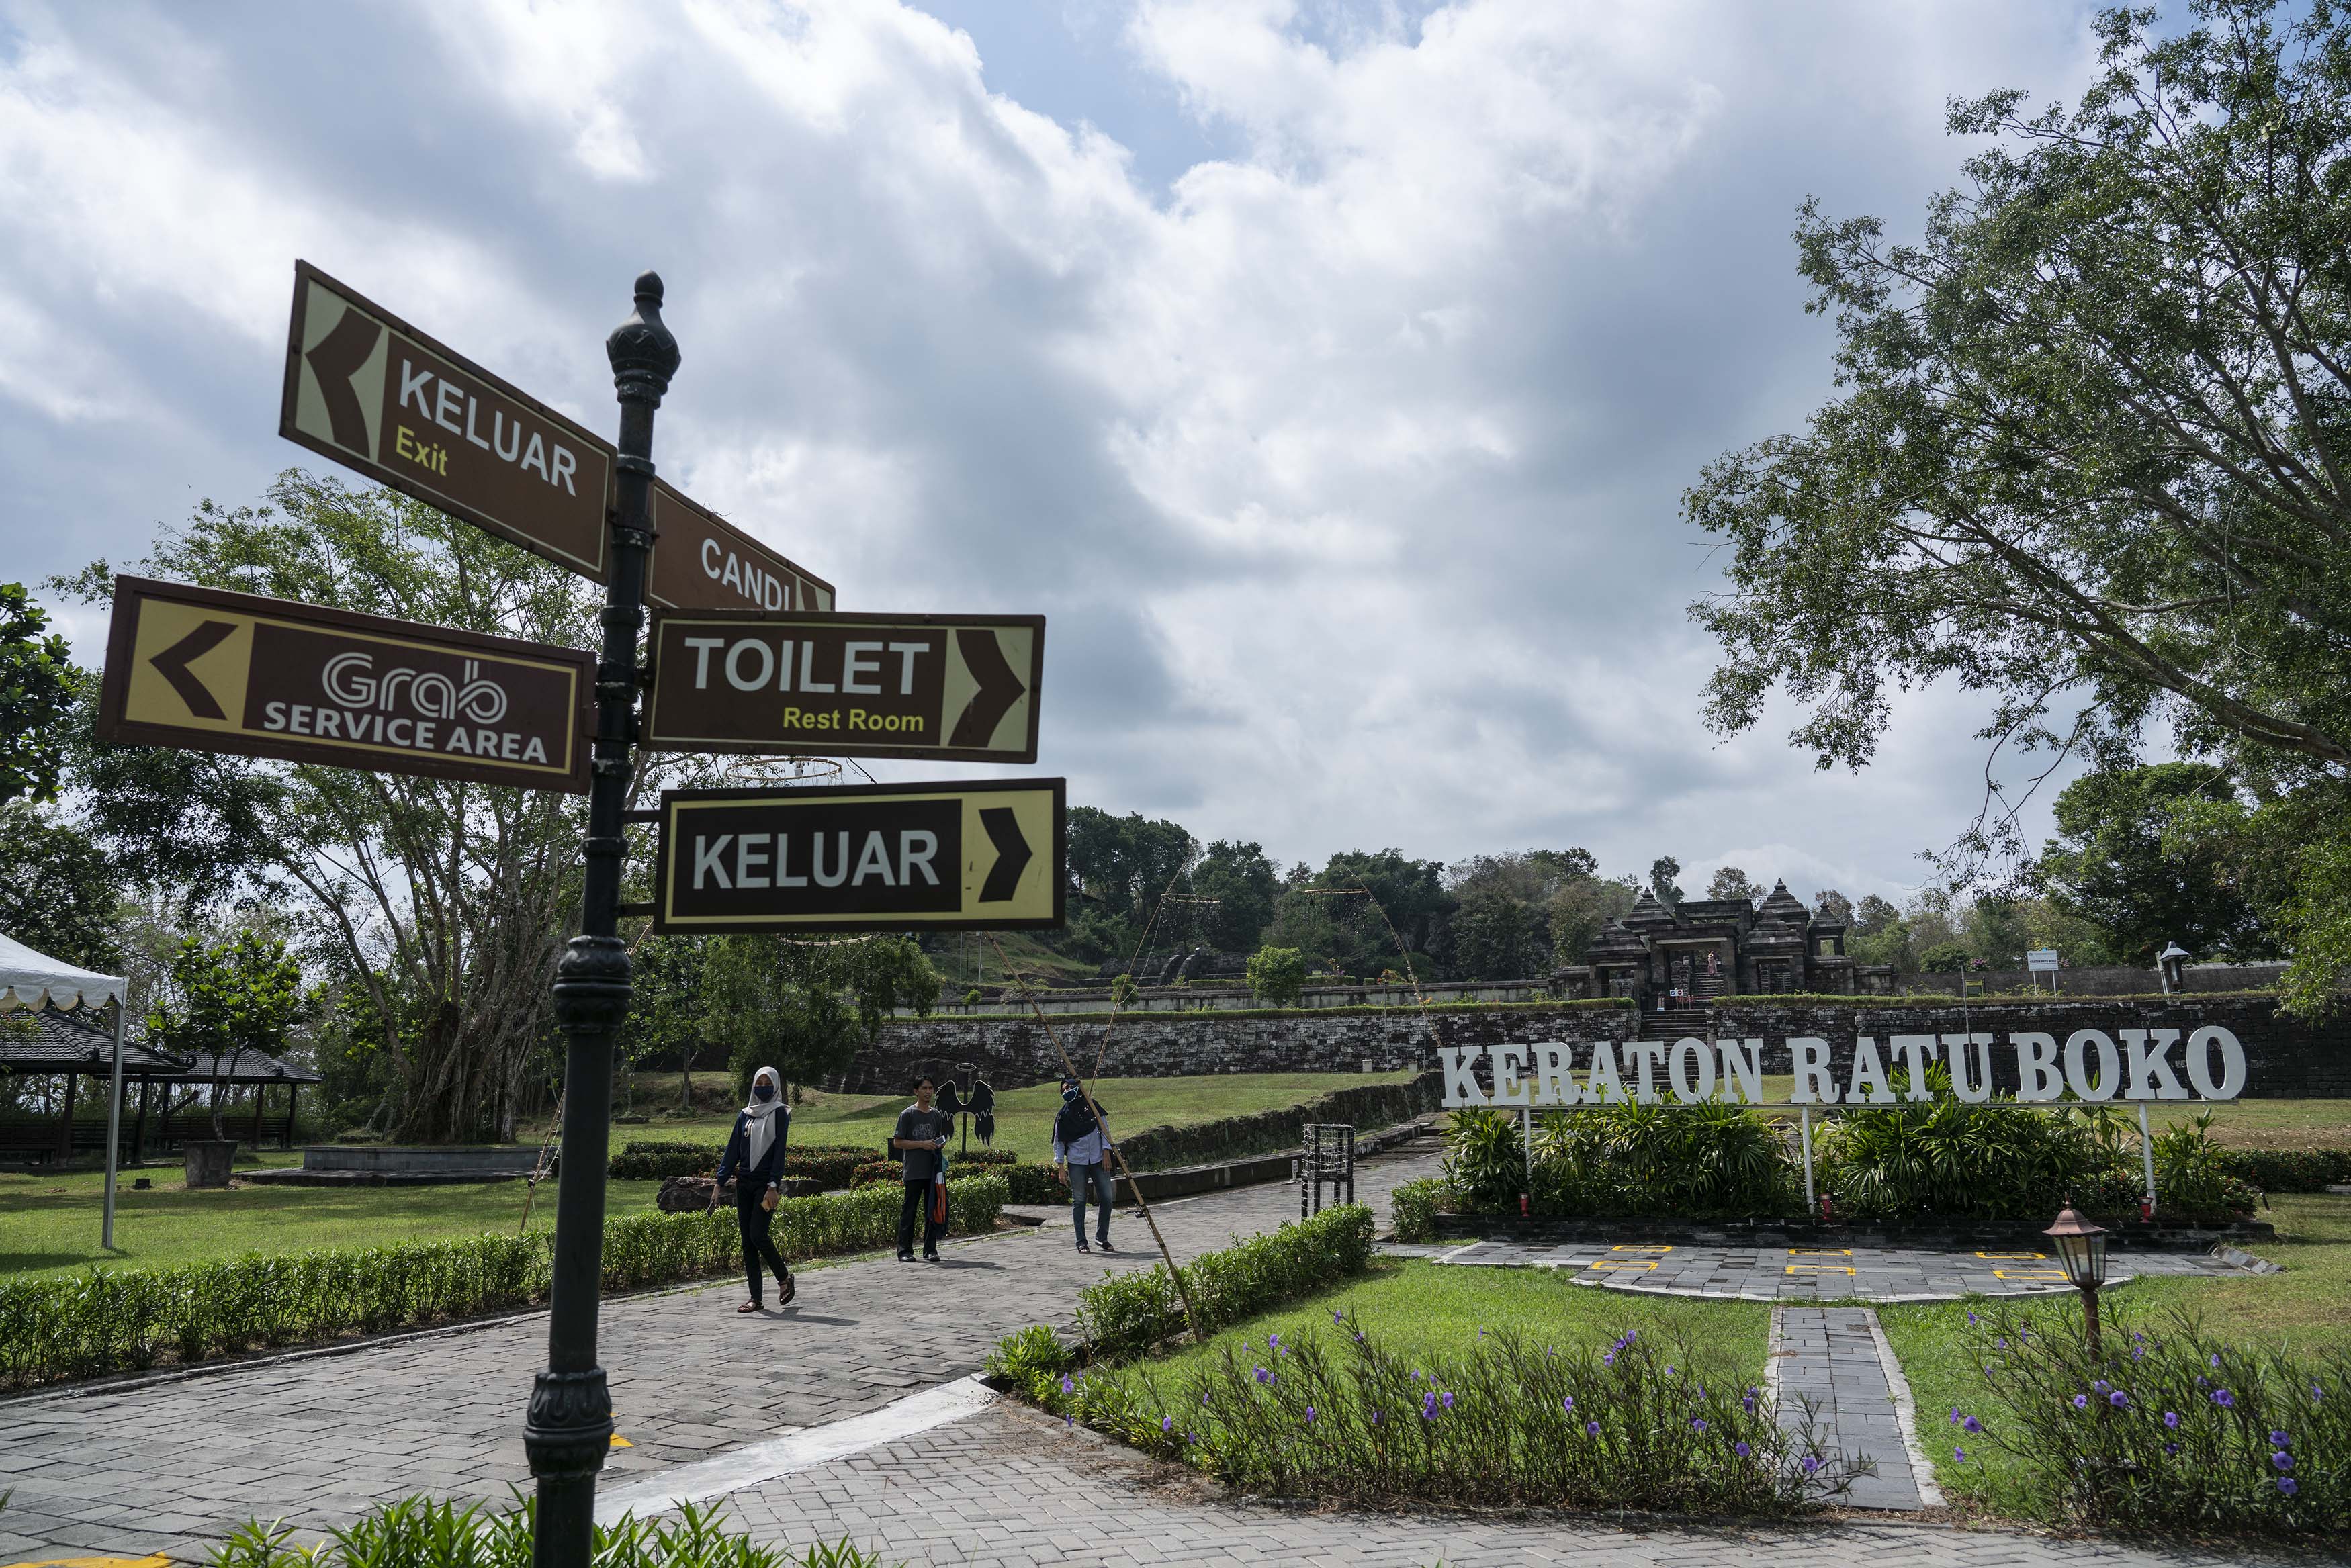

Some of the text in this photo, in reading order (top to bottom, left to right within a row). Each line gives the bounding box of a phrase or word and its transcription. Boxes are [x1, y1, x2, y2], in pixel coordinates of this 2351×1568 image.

[396, 425, 447, 477] Exit
[400, 359, 576, 496] KELUAR
[701, 538, 790, 611] CANDI
[322, 652, 507, 724] Grab
[684, 637, 930, 694] TOILET
[264, 702, 547, 764] SERVICE AREA
[783, 707, 924, 731] Rest Room
[693, 830, 940, 889] KELUAR
[1437, 1025, 2246, 1107] KERATON RATU BOKO
